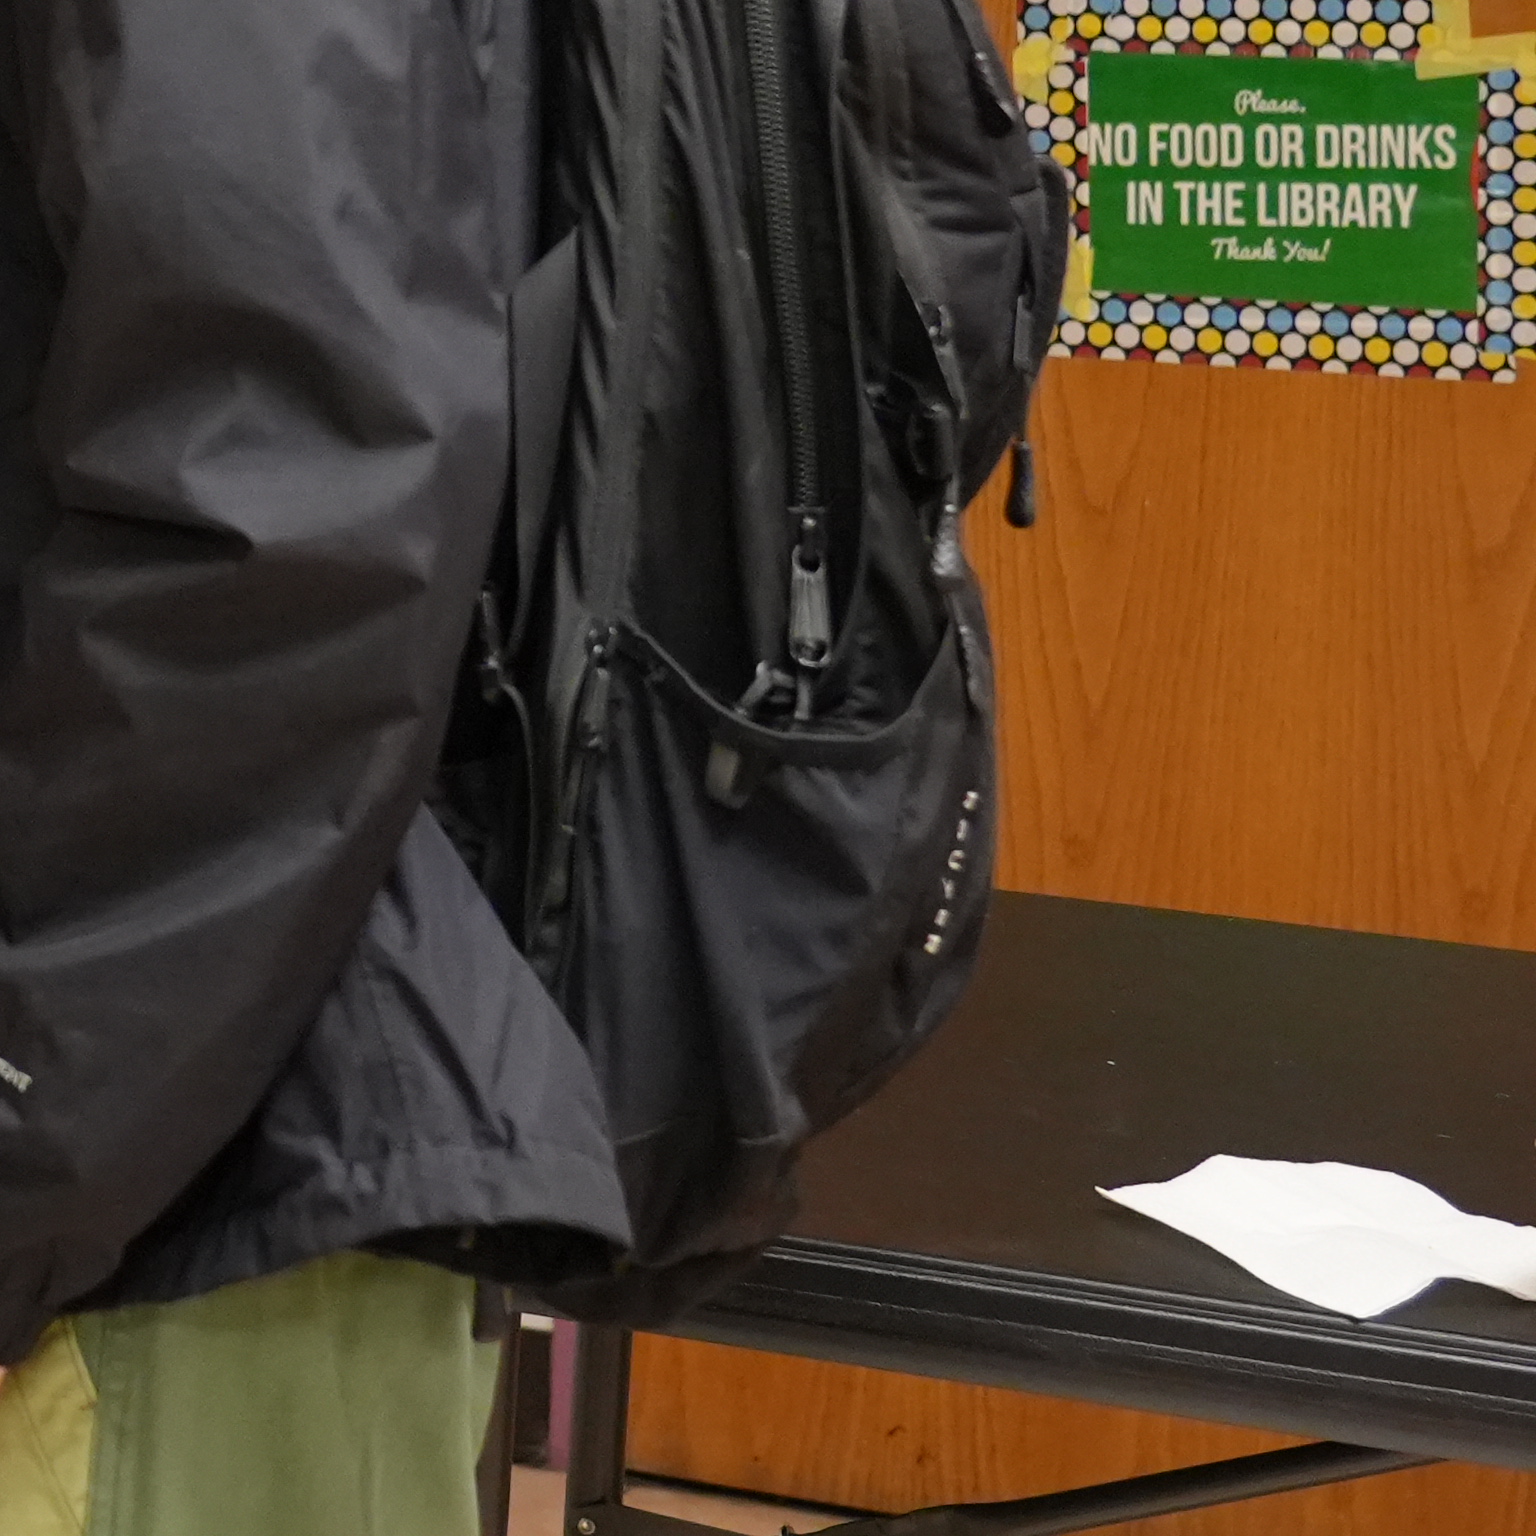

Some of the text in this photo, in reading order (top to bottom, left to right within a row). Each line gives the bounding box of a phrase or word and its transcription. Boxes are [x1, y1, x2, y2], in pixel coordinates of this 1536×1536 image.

[1088, 122, 1458, 170] NO FOOD OR DRINKS
[1126, 181, 1418, 229] IN THE LIBRARY
[1211, 236, 1332, 263] Thank You!
